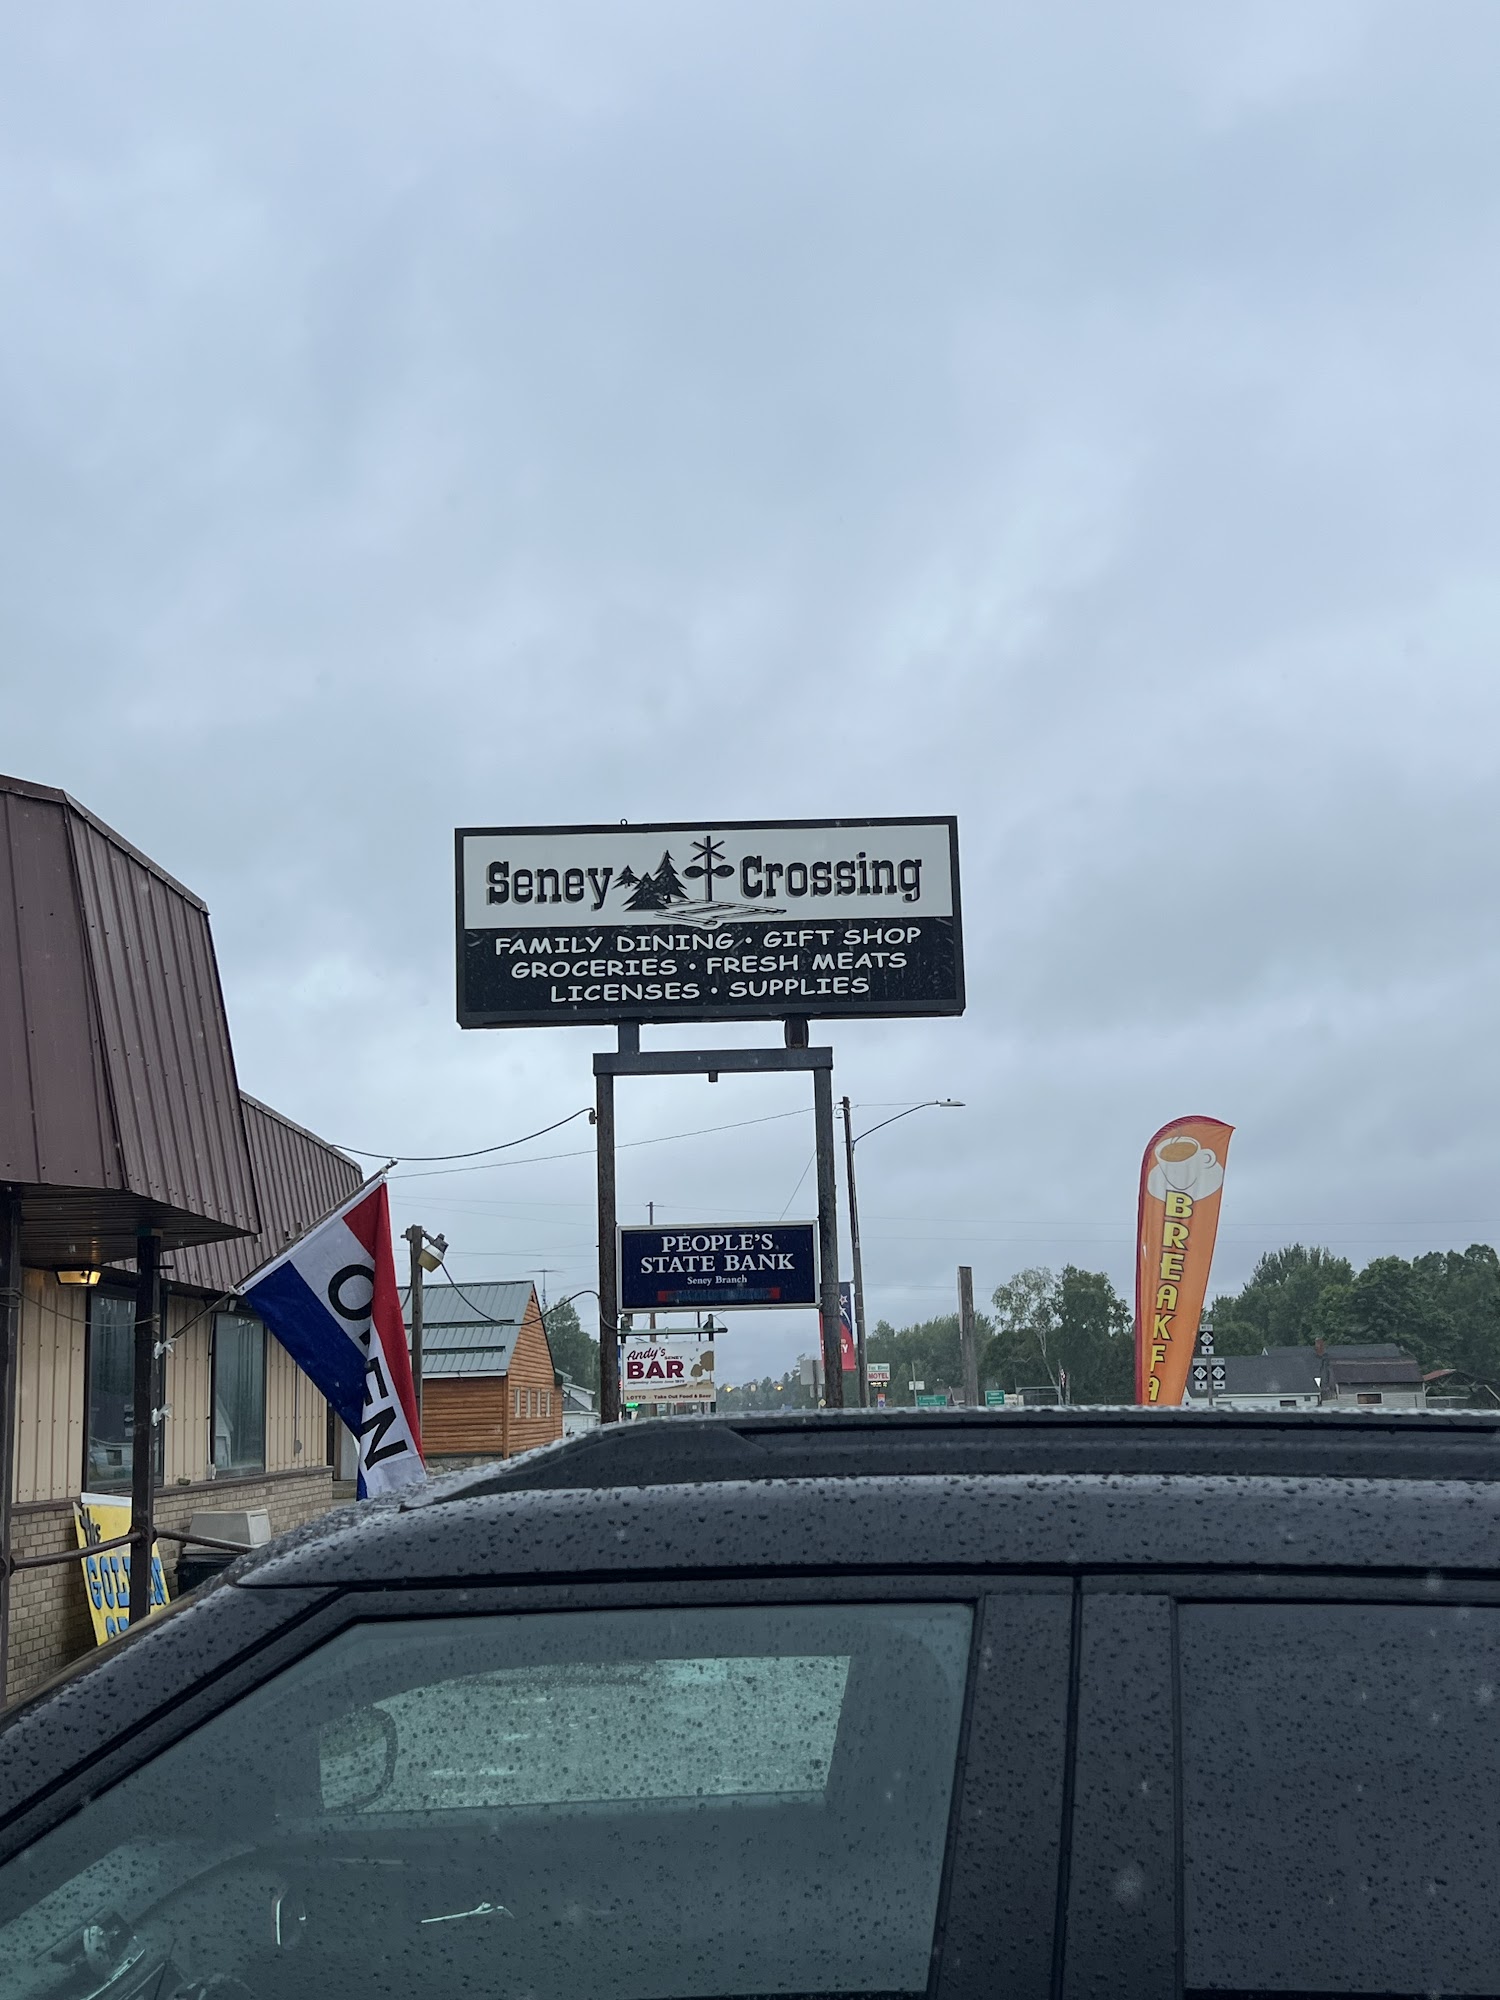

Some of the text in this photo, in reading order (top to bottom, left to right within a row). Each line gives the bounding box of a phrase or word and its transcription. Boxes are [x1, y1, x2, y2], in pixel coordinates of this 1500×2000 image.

[486, 852, 922, 912] Seney Crossing
[495, 927, 922, 956] FAMILY DINING GIFT SHOP
[510, 952, 908, 980] GROCERIES FRESH MEATS
[550, 977, 870, 1003] LICENSES SUPPLIES
[661, 1233, 774, 1253] PEOPLE'S
[640, 1253, 795, 1274] STATE BANK
[686, 1274, 748, 1286] Seney Branch
[626, 1346, 666, 1360] Andy's
[328, 1264, 408, 1470] OEN
[627, 1360, 684, 1380] BAR
[86, 1556, 166, 1610] GOLN
